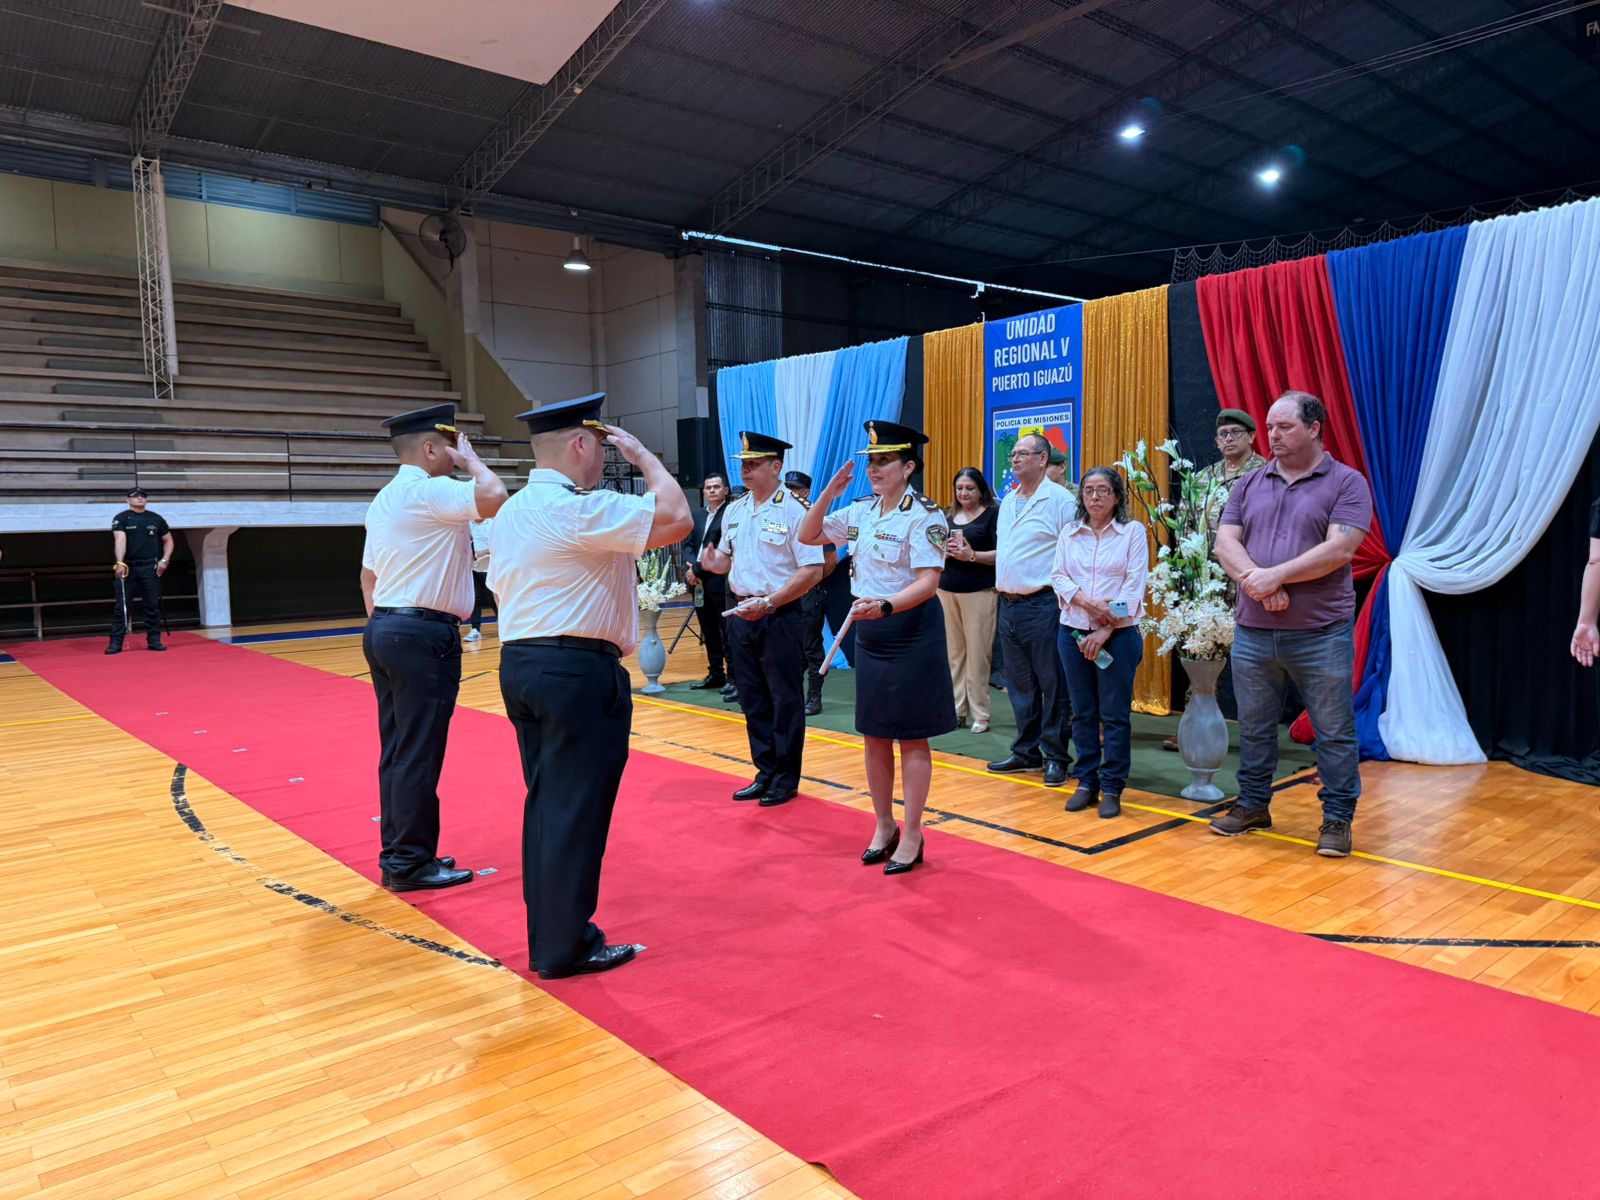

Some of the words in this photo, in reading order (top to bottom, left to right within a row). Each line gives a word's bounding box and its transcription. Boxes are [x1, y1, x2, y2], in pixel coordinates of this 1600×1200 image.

[1006, 313, 1056, 340] UNIDAD
[994, 339, 1058, 368] REGIONAL
[1060, 336, 1070, 357] V
[992, 371, 1030, 393] PUERTO
[1033, 362, 1073, 387] IGUAZÚ
[996, 418, 1021, 428] POLICIA
[1022, 417, 1032, 425] DE
[1033, 414, 1070, 424] MISIONES
